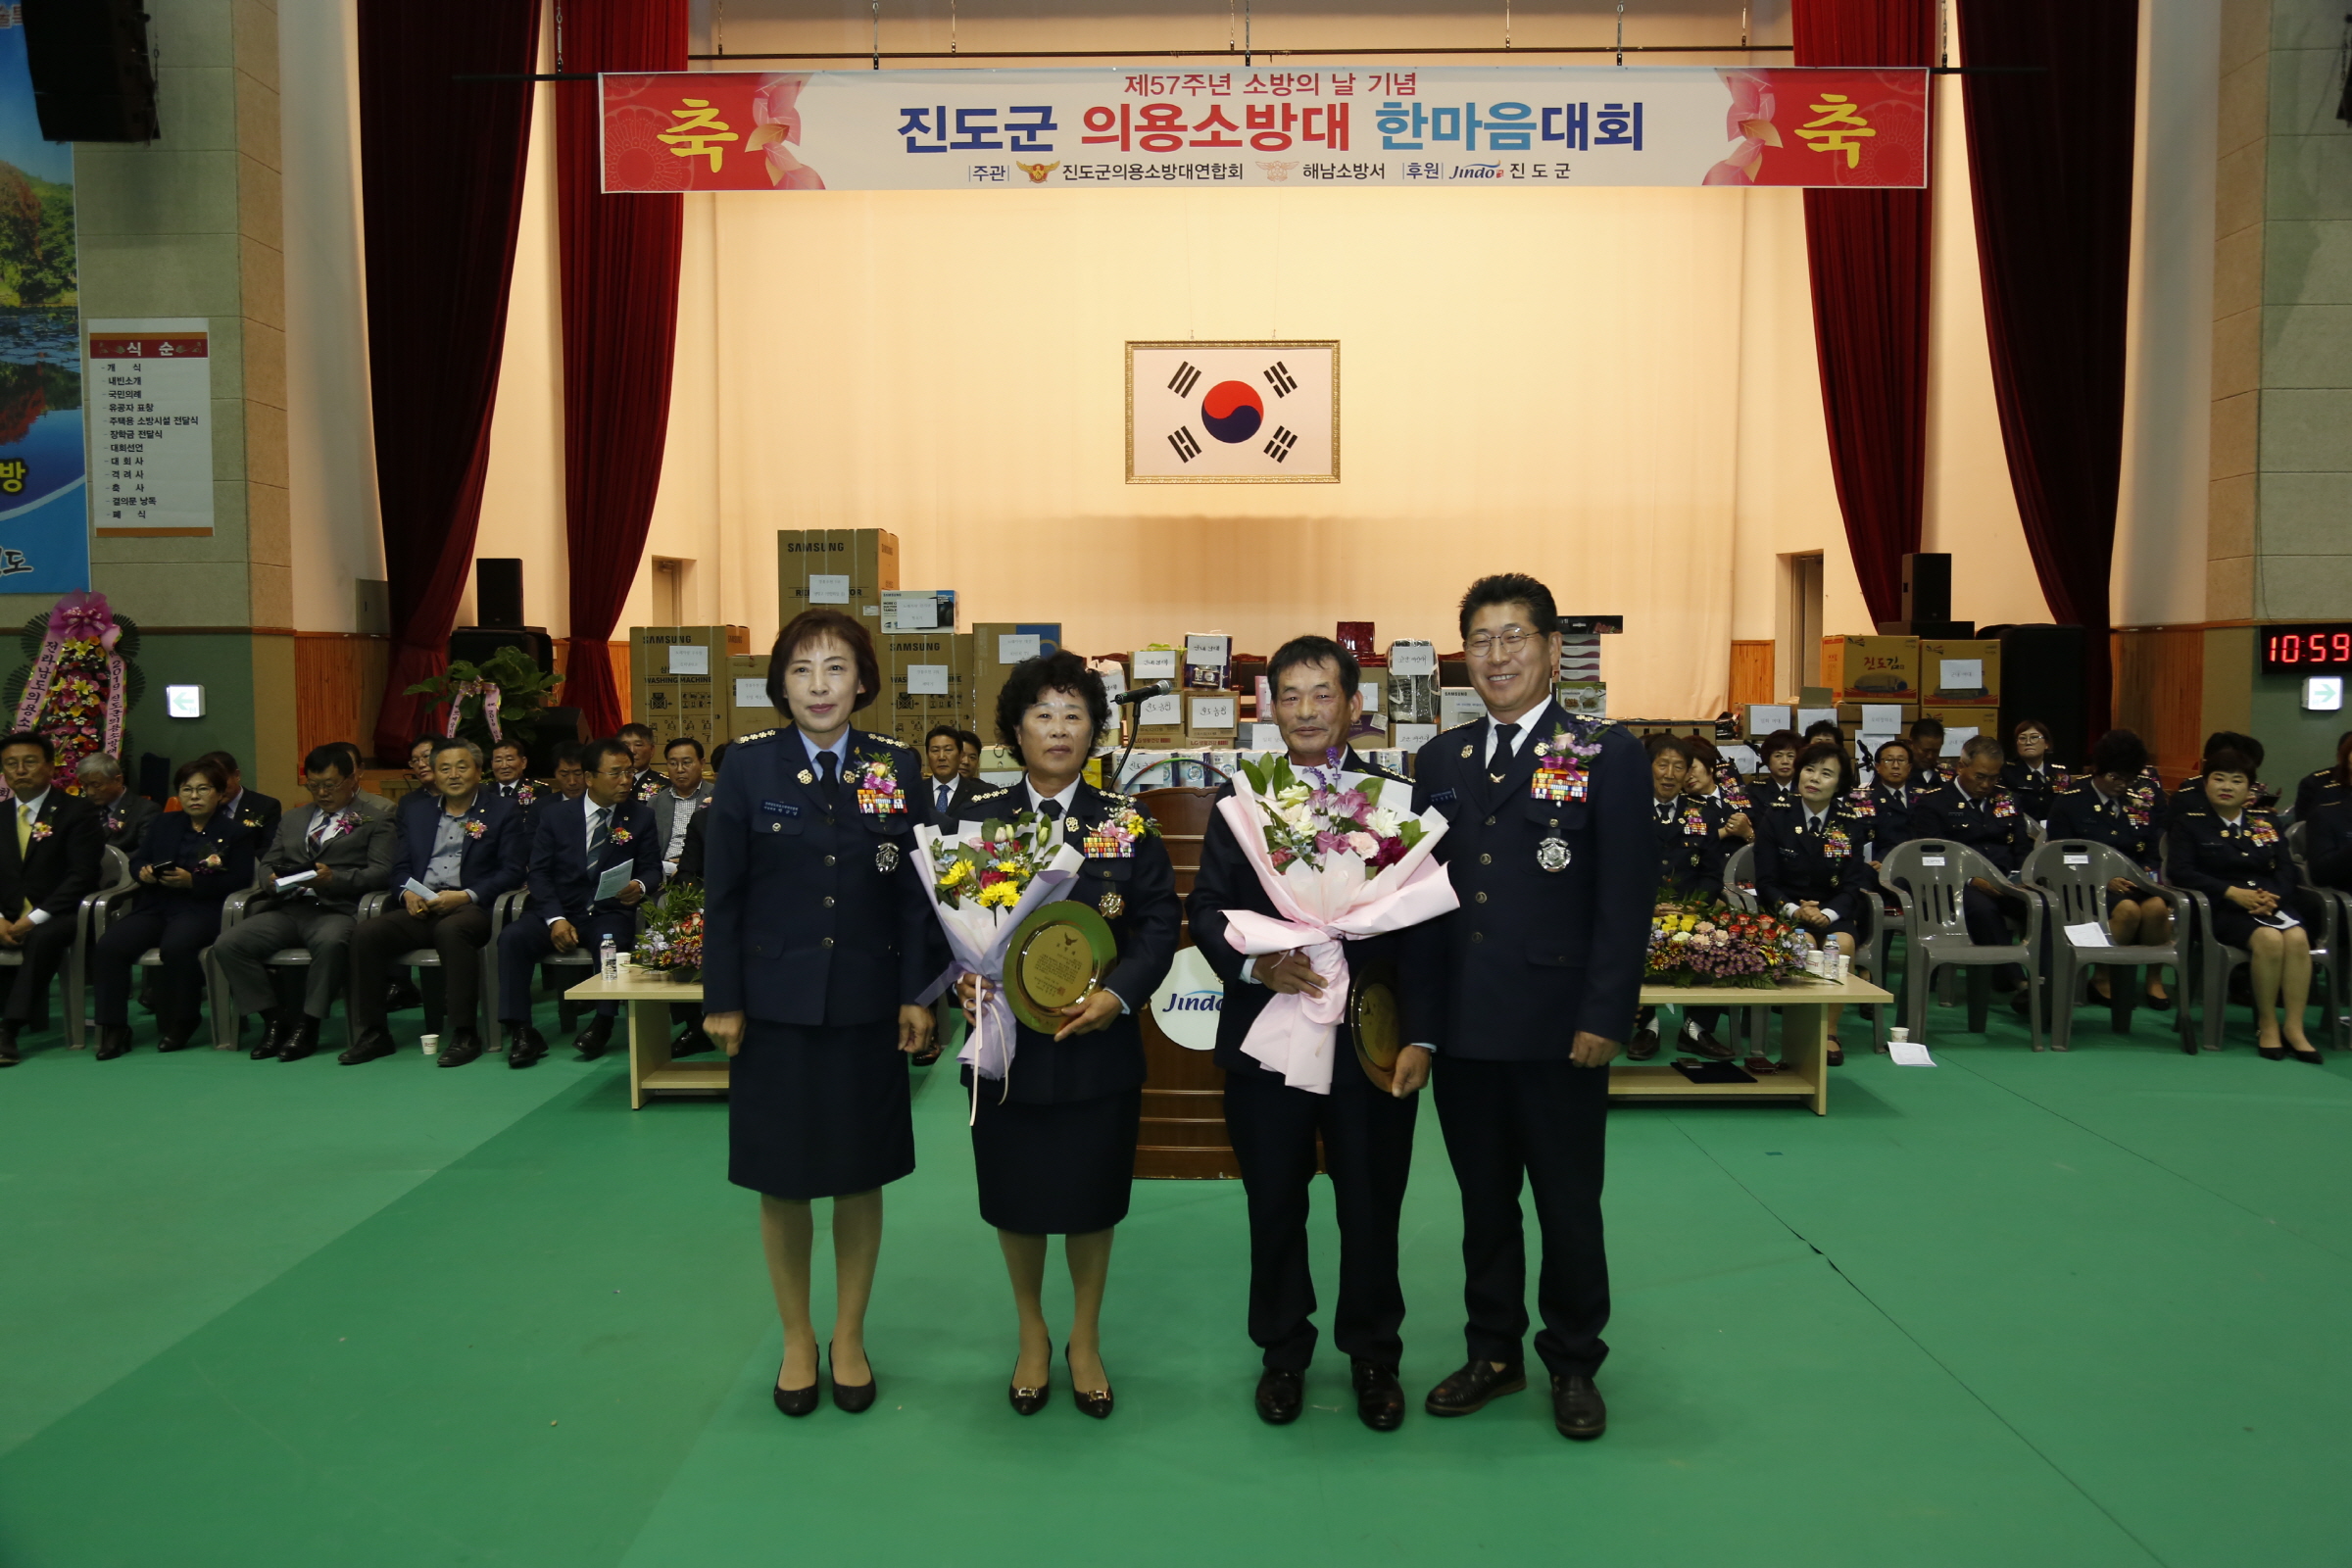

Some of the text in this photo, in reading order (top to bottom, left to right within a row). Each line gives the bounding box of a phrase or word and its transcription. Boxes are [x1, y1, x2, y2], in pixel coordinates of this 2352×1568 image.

[1124, 73, 1416, 97] 제57주년 소방의 날 기념
[897, 105, 1058, 153] 진도군
[1081, 102, 1349, 153] 의용소방대
[1793, 92, 1876, 170] 축
[657, 99, 739, 173] 축
[1062, 163, 1244, 181] 진도군의용소방대연합회
[1302, 162, 1386, 180] 해남소방서
[1448, 164, 1496, 179] Jindo
[108, 376, 142, 386] 내빈소개
[108, 390, 142, 399] 국민의례
[109, 403, 154, 413] 유공자 표창
[109, 416, 199, 426] 주택용 소방시설 전달식
[110, 429, 163, 439] 장학금 전달식
[111, 443, 144, 453] 대회선언
[112, 497, 157, 507] 결의문 낭독
[788, 542, 845, 553] SAMSUNG
[643, 635, 692, 644] SAMSUNG
[2270, 633, 2350, 663] 10:59
[17, 641, 59, 735] 전라남도의용소
